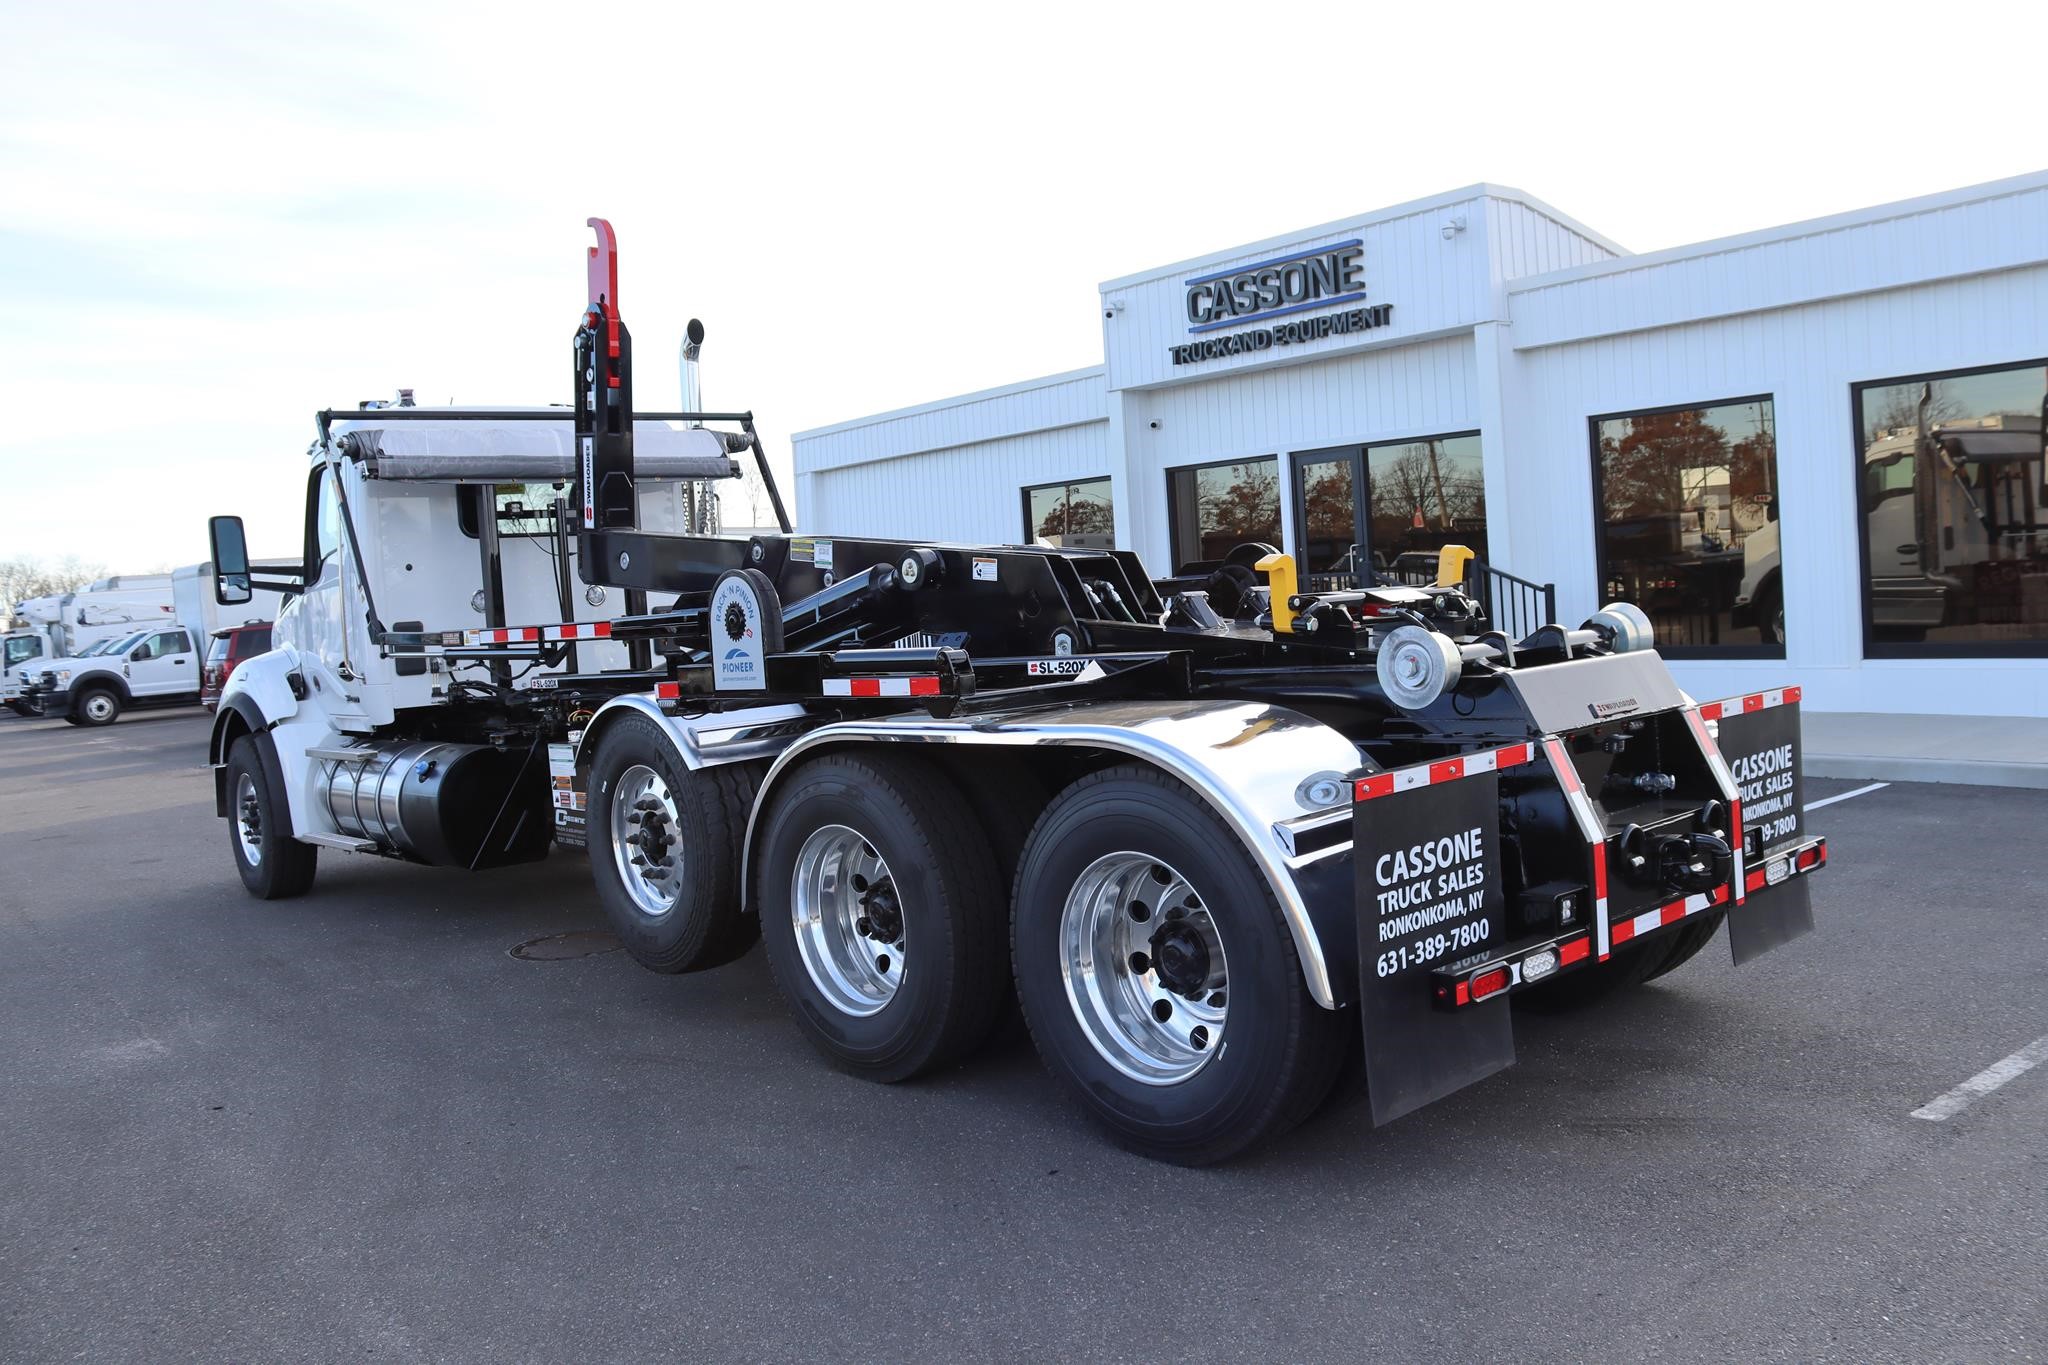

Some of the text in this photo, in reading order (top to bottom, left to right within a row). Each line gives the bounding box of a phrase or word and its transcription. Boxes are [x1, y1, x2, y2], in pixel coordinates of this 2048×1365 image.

[1187, 247, 1366, 323] CASSONE
[1168, 303, 1394, 365] TRUCK AND EQUIPMENT
[716, 591, 728, 622] RACK
[735, 585, 755, 620] PINION
[722, 662, 754, 673] PIONEER
[1732, 744, 1793, 784] CASSONE
[1739, 771, 1793, 803] RUCK SALES
[1743, 792, 1793, 823] NKONKOMA, NY
[1375, 827, 1483, 887] CASSONE
[1377, 863, 1484, 915] TRUCK SALES
[1379, 890, 1485, 942] RONKONKOMA, NY
[1377, 918, 1489, 978] 631-389-7800
